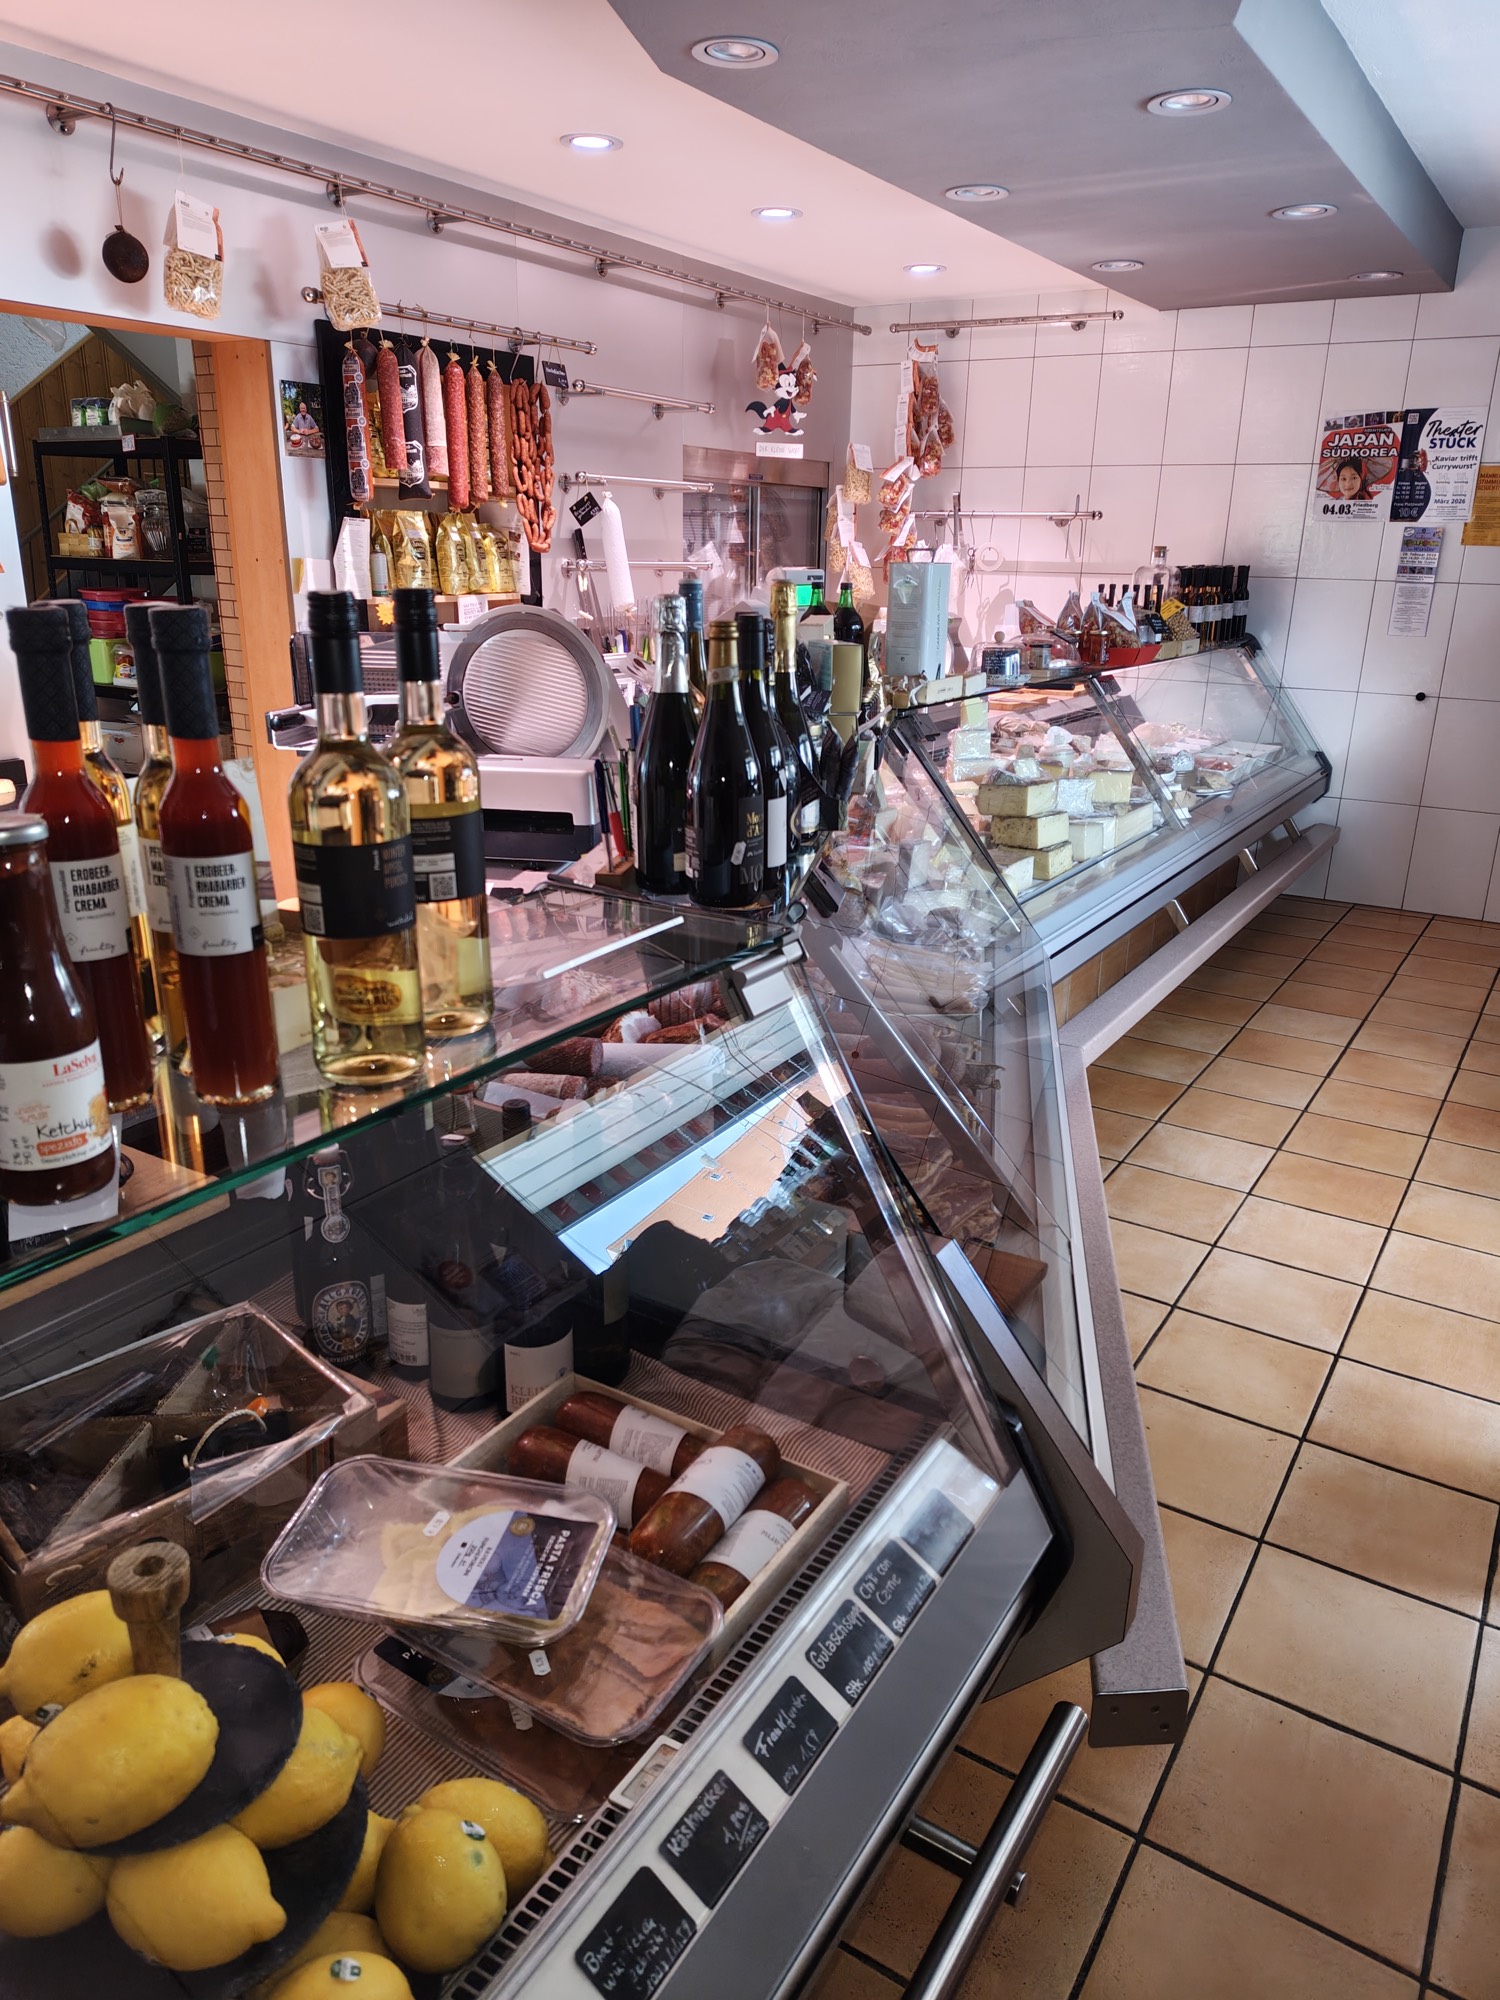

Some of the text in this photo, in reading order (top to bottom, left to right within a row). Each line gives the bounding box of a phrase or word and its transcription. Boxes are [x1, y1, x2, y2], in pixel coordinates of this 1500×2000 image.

[1426, 420, 1483, 437] Theater
[1328, 433, 1395, 447] JAPAN
[1428, 434, 1477, 449] STÜCK
[1322, 447, 1398, 457] SÜDKOREA
[70, 865, 112, 881] ERDBEER-
[194, 864, 238, 878] ERDBEER-
[72, 878, 120, 897] RHABARBER
[196, 877, 246, 893] RHABARBER
[74, 897, 107, 913] CREMA
[198, 895, 230, 908] CREMA
[548, 1529, 571, 1564] PASTA
[876, 1558, 892, 1576] con
[525, 1565, 555, 1606] FRESCA
[754, 1693, 807, 1758] Frankfurter
